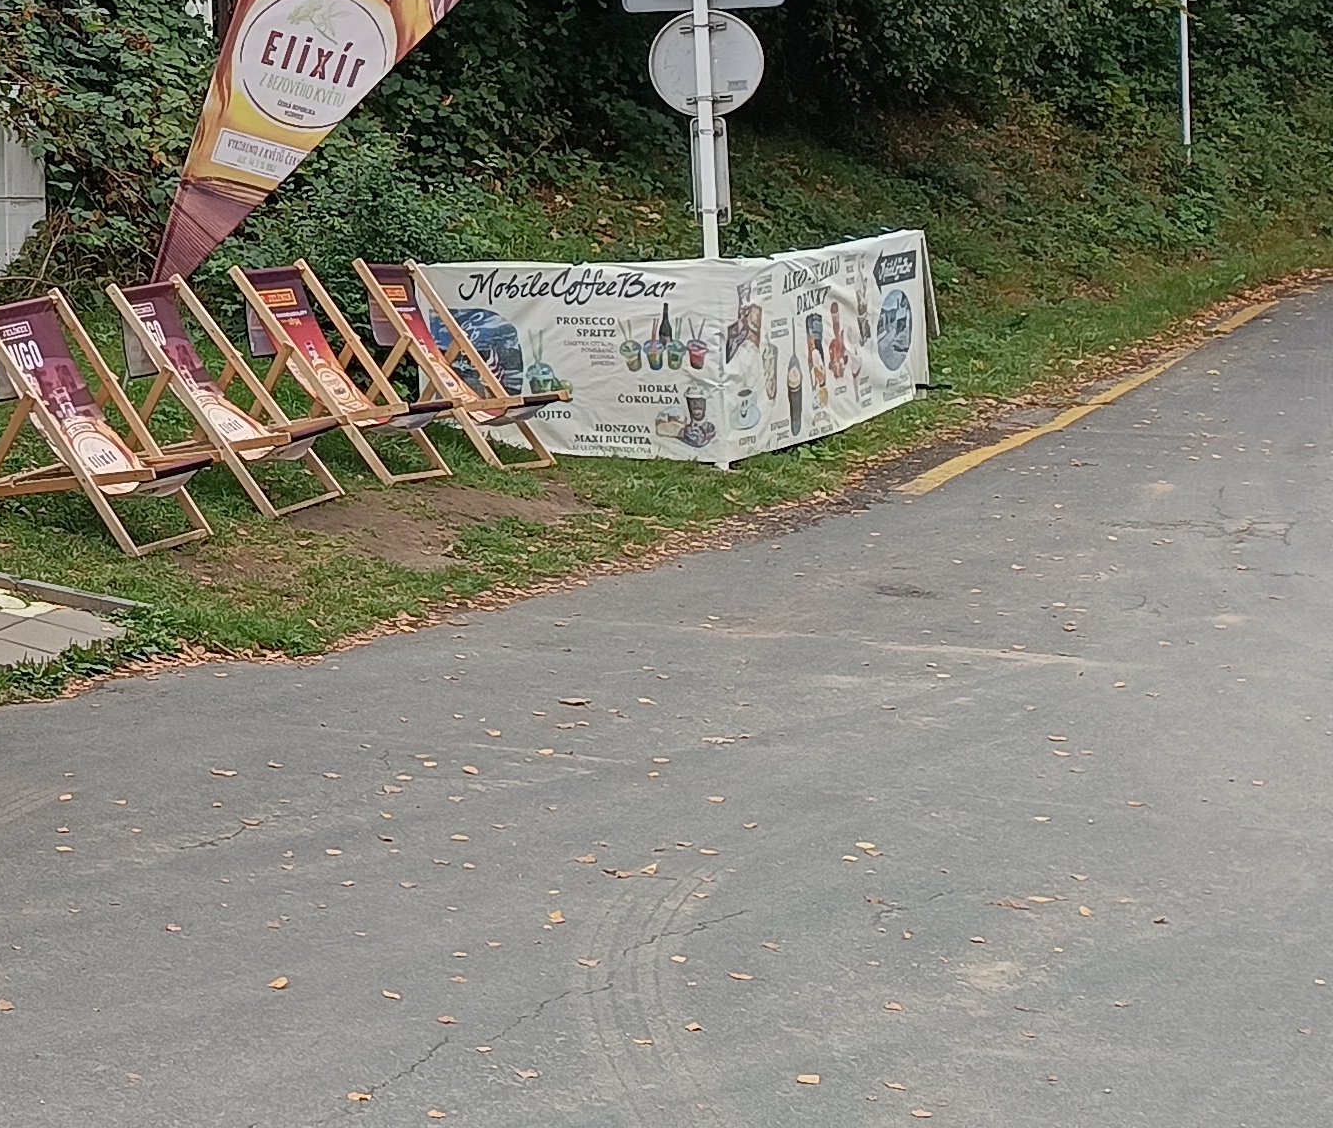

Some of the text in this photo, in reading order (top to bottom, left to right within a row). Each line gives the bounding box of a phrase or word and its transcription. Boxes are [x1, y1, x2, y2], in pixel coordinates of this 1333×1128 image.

[261, 30, 366, 88] Elixír
[267, 74, 312, 100] BEZOVÉHO
[314, 84, 347, 108] KVĚTU
[458, 268, 676, 305] MobileCoffeeBar
[556, 316, 616, 326] PROSECCO
[576, 328, 617, 338] SPRITZ
[8, 340, 44, 372] UGO
[638, 384, 679, 393] HORKÁ
[618, 393, 680, 405] ČOKOLÁDA
[595, 424, 651, 433] HONZOVA
[574, 434, 652, 445] MAXI BUCHTA
